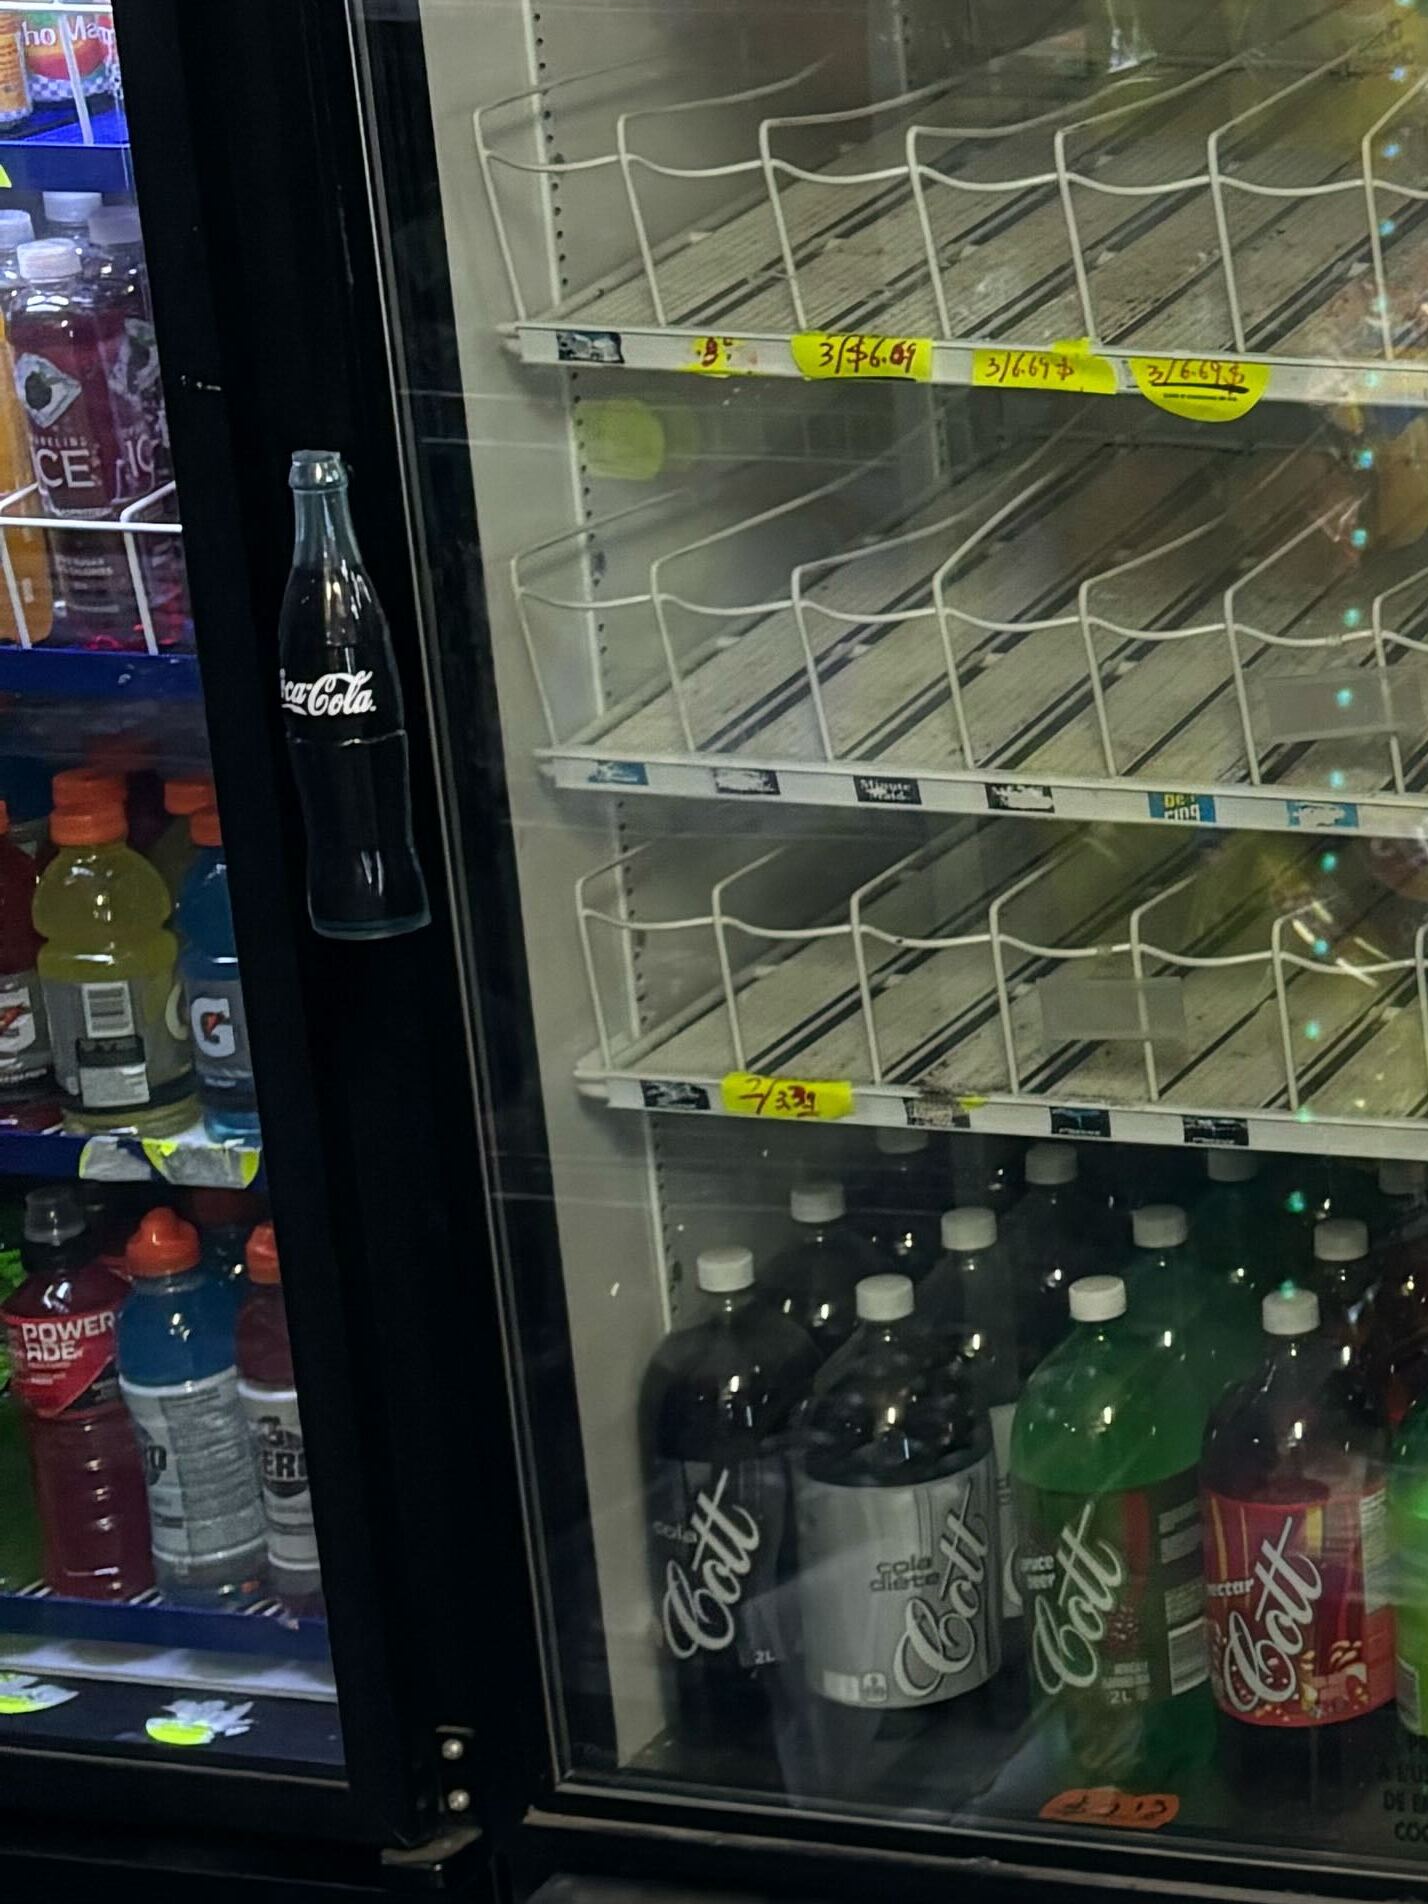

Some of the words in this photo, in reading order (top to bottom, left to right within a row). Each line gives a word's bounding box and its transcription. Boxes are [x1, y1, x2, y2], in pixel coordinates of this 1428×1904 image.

[22, 1310, 116, 1343] POWER
[663, 1468, 760, 1660] Cott
[877, 1553, 934, 1575] cola
[894, 1478, 991, 1698] Cott
[1032, 1500, 1124, 1696] Cott
[1223, 1515, 1324, 1713] Cott
